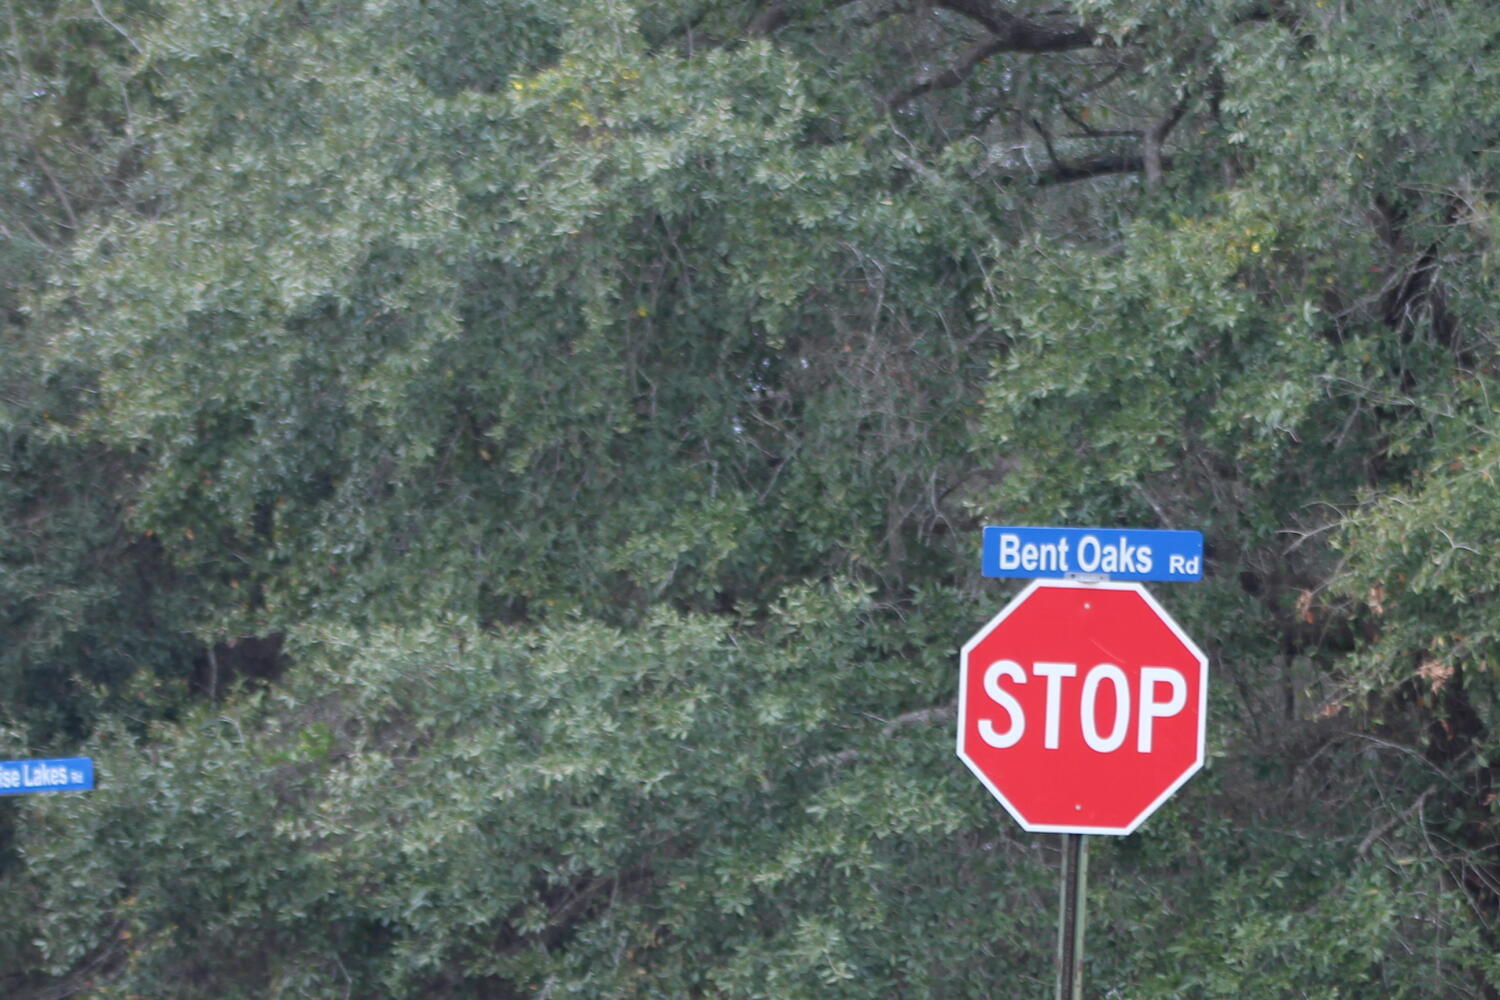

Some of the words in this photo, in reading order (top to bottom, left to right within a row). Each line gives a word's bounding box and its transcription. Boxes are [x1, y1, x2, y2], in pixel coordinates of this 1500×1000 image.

[1000, 534, 1068, 571] Bent
[1077, 535, 1152, 573] Oaks
[1169, 554, 1199, 574] Rd
[977, 659, 1187, 753] STOP
[23, 764, 68, 787] Lakes
